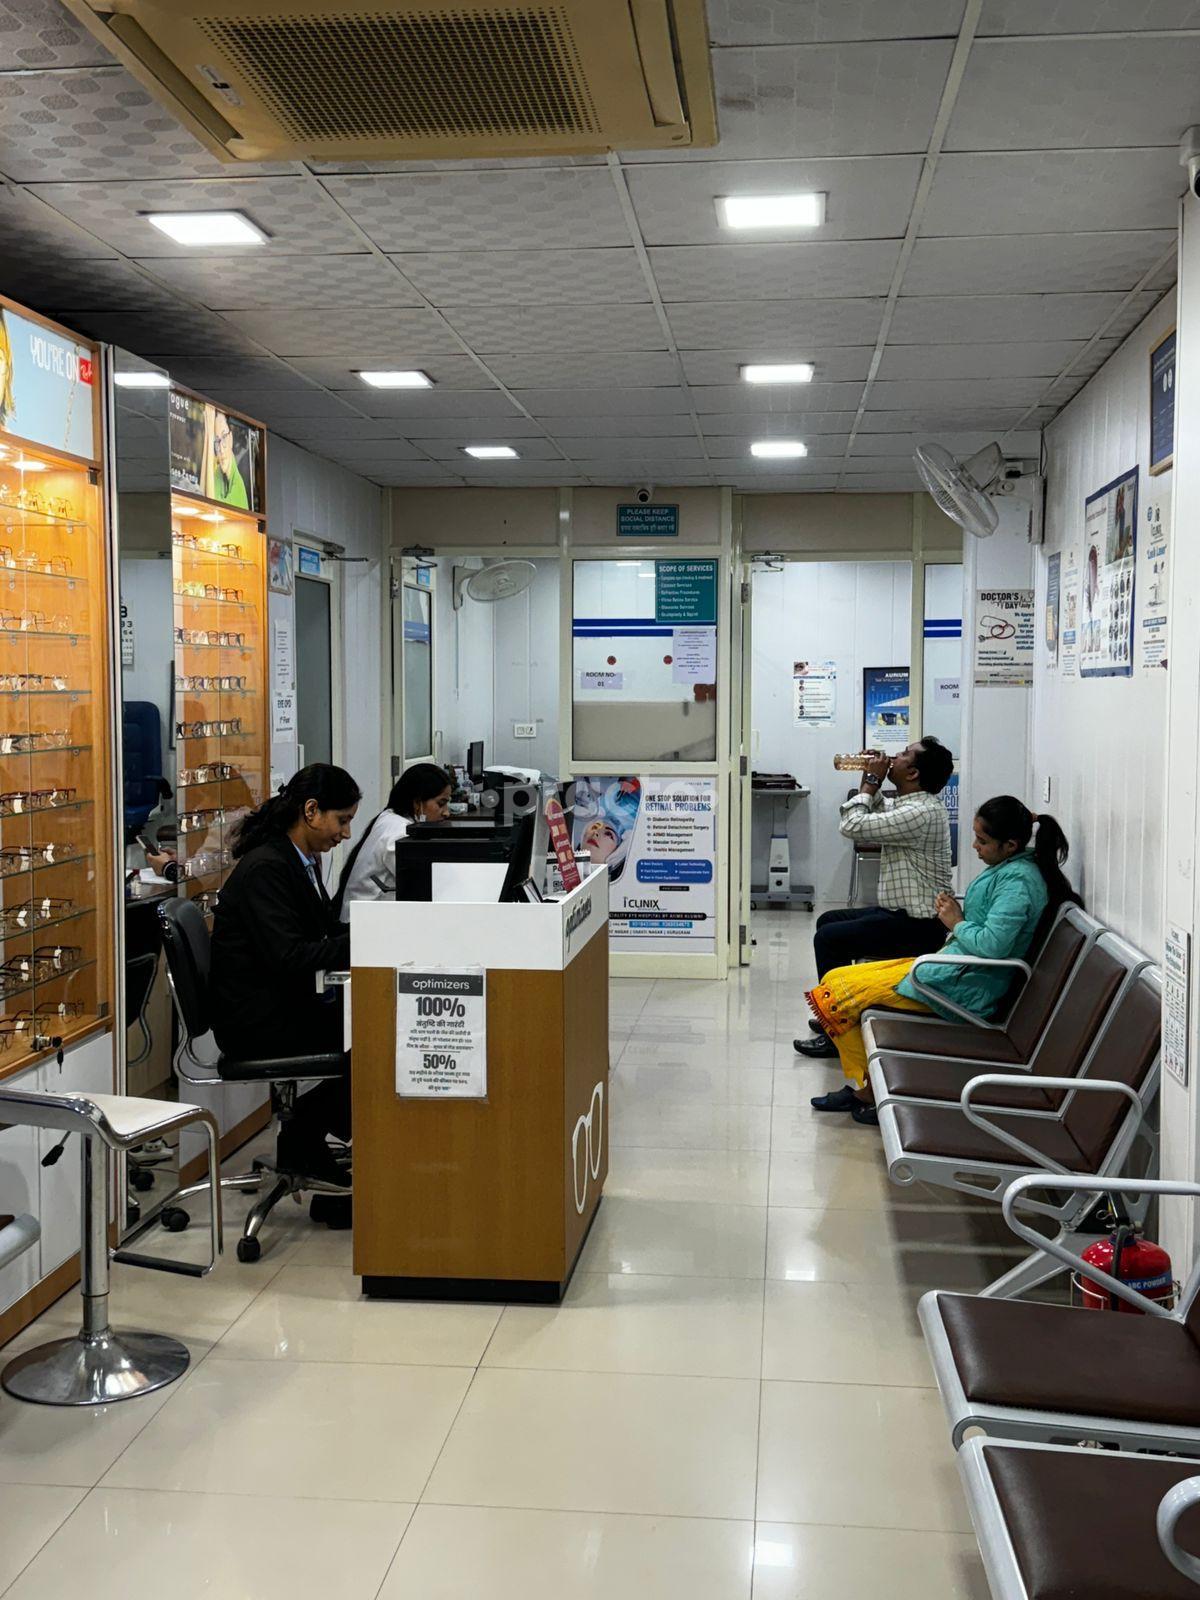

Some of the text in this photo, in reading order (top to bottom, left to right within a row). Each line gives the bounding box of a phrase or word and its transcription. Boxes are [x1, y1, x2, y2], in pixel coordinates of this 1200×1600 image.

[30, 334, 80, 384] YOU'RE ON
[168, 391, 189, 410] ogue
[981, 592, 1019, 601] DOCTOR'S
[645, 803, 712, 811] RETINAL PROBLEMS
[628, 899, 660, 911] CLINIX
[412, 979, 470, 990] optimizers
[416, 996, 466, 1017] 100%
[436, 1019, 446, 1028] की
[423, 1054, 457, 1070] 50%
